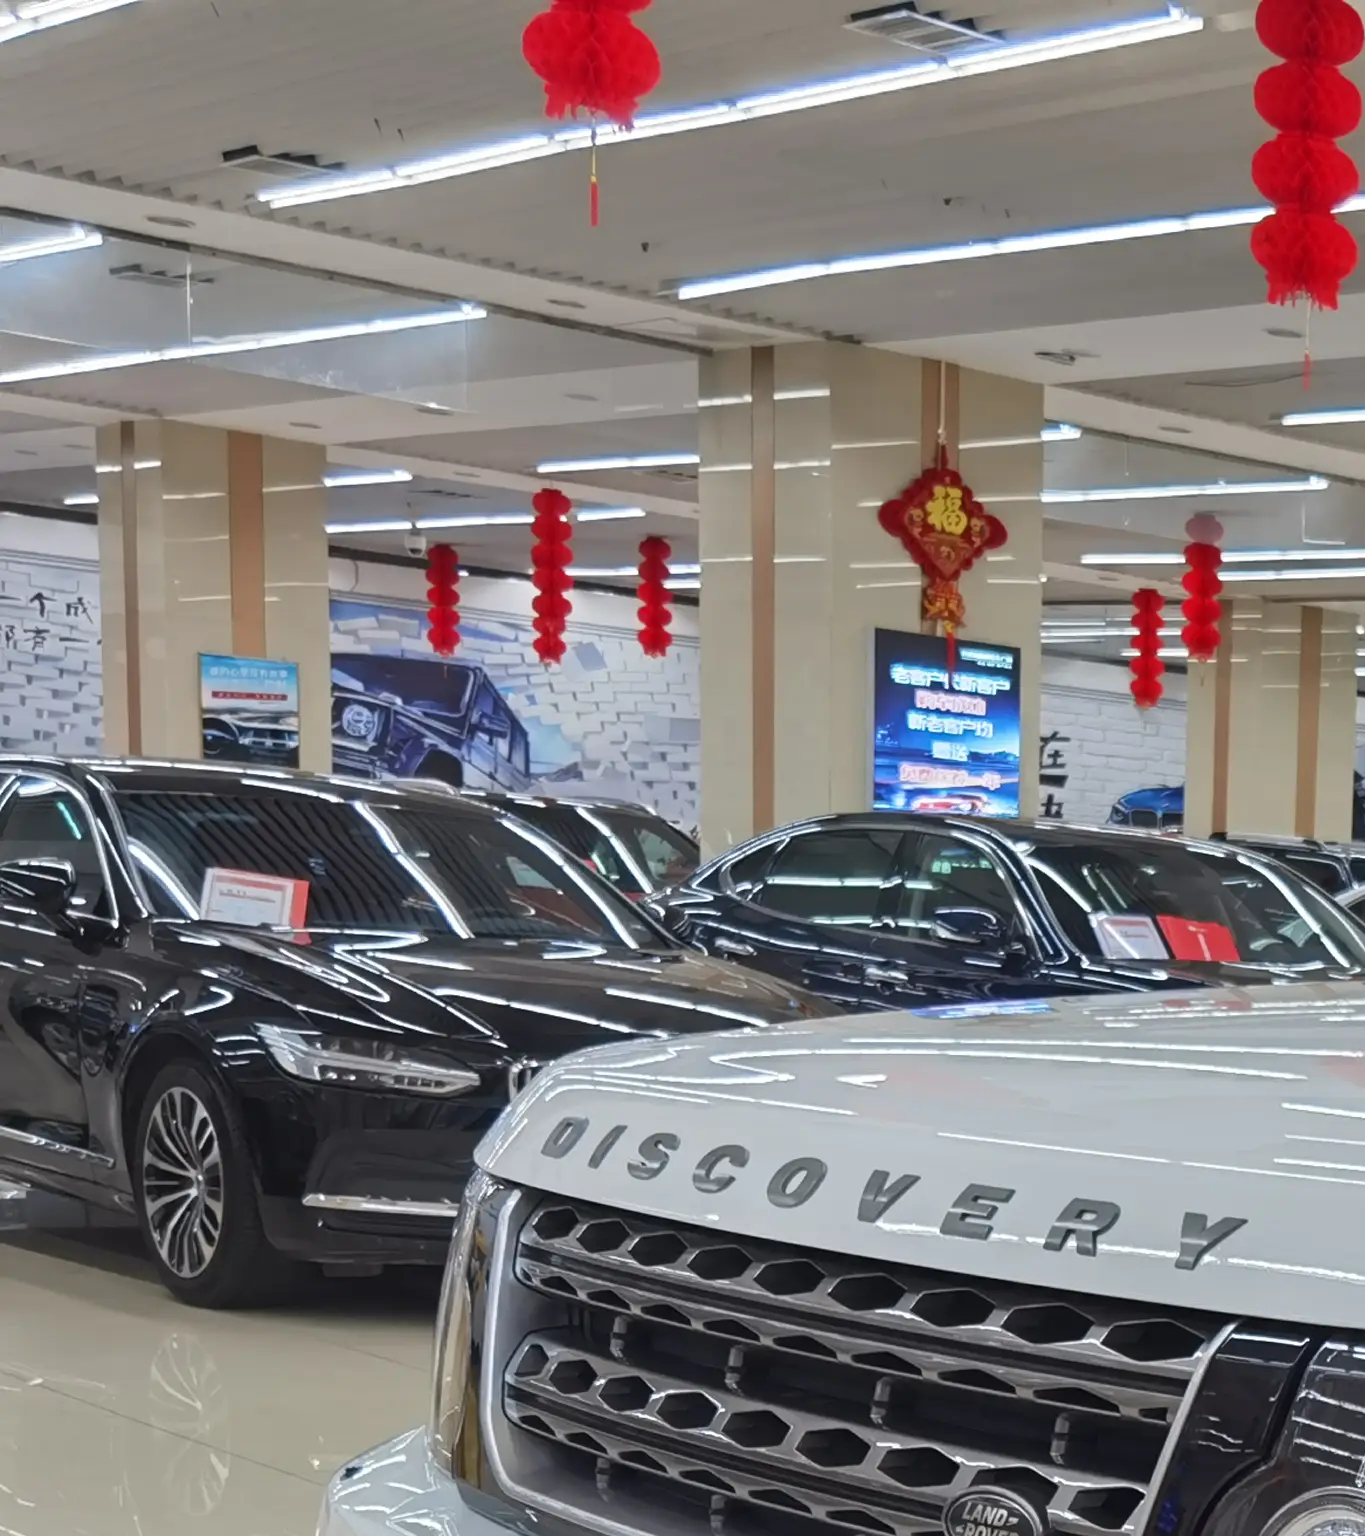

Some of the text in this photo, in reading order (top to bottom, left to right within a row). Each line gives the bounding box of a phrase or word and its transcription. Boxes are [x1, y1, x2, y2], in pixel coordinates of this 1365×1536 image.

[925, 485, 968, 536] 福
[540, 1116, 1249, 1270] DISCOVERY
[962, 1501, 1008, 1527] LAND
